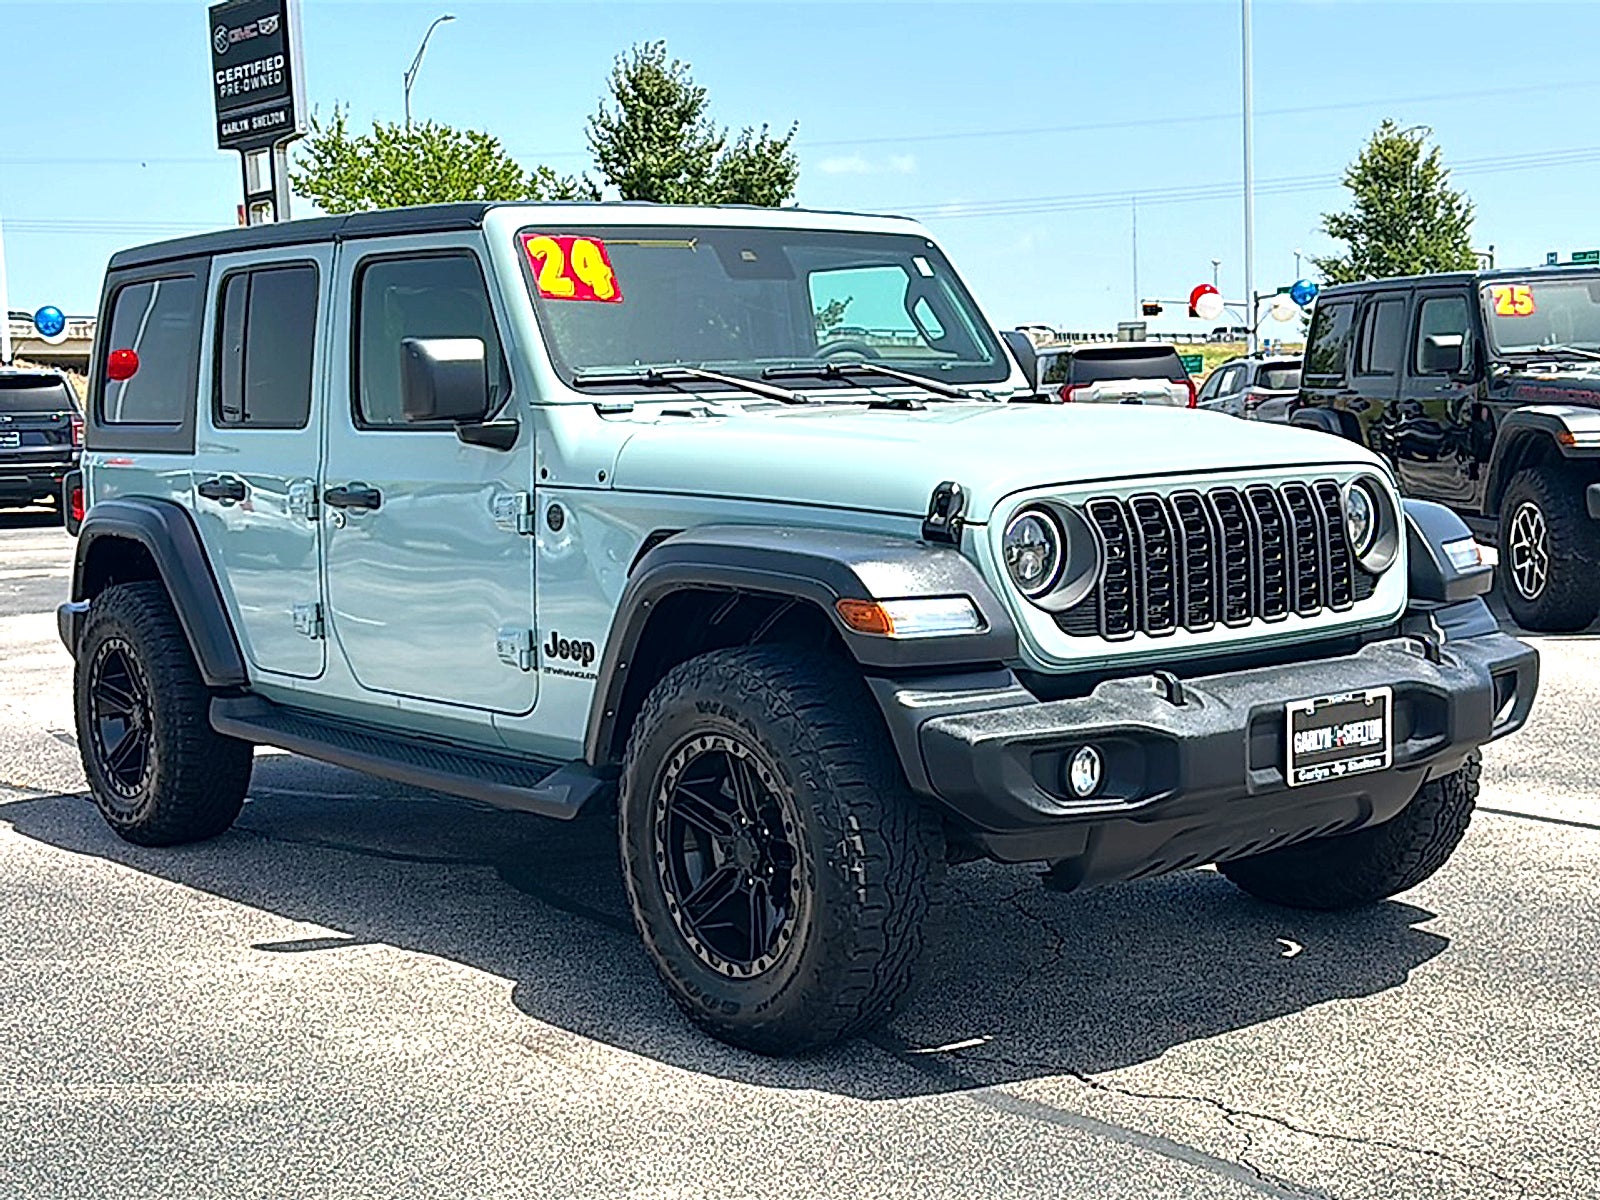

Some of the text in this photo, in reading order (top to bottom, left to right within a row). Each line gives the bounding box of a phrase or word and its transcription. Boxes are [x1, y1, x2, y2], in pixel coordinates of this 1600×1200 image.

[228, 24, 258, 43] GMC
[216, 55, 284, 84] CERTIFIED
[220, 71, 282, 98] PRE-OWNED
[527, 236, 615, 300] 24
[1490, 284, 1534, 315] 25
[544, 631, 595, 667] Jeep
